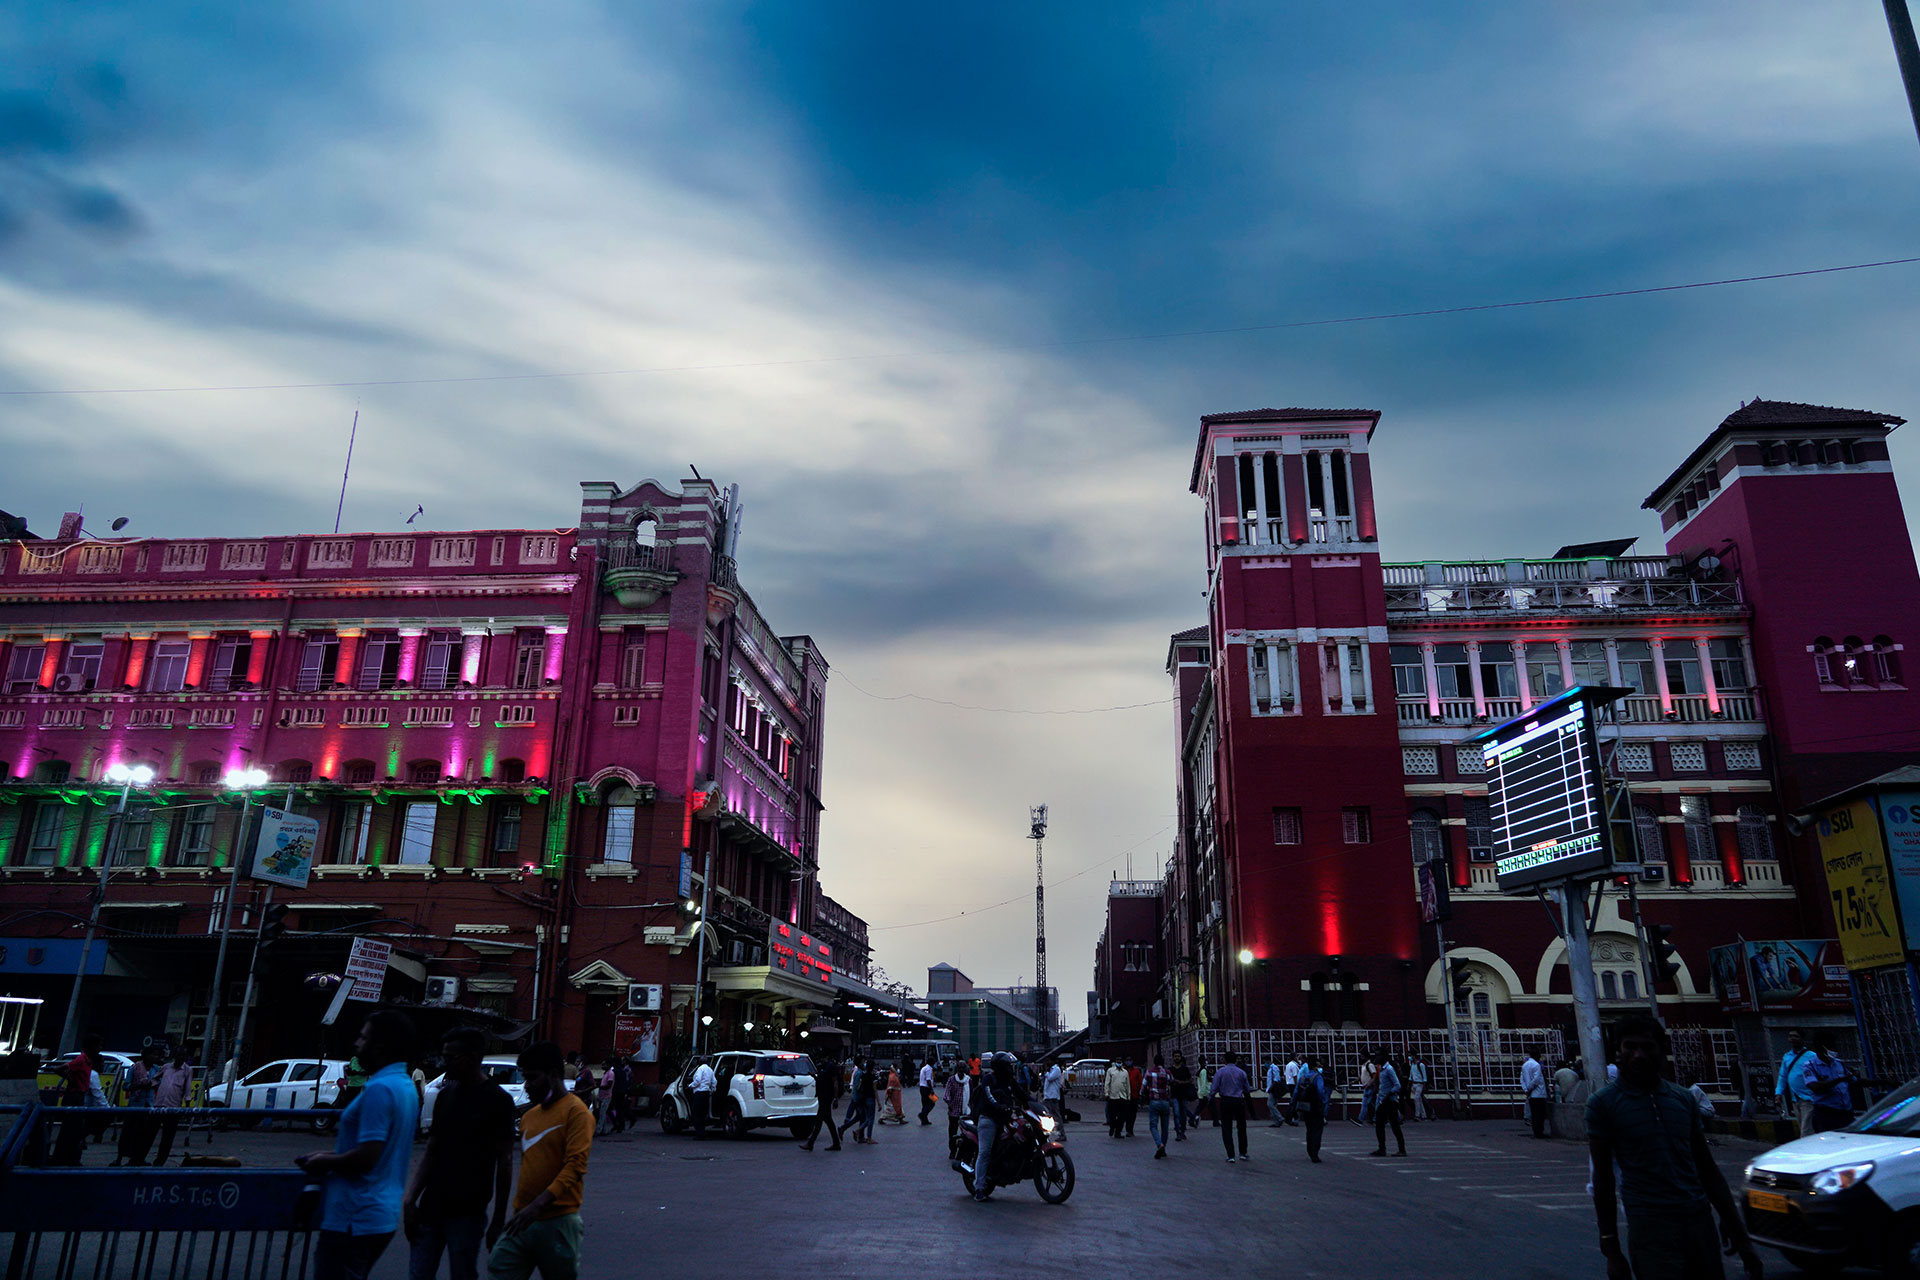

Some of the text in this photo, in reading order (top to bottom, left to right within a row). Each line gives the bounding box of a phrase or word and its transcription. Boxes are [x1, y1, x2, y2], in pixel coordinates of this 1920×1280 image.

[271, 810, 283, 820] SBI
[1831, 808, 1854, 834] SBI
[1831, 885, 1873, 933] 7.5%
